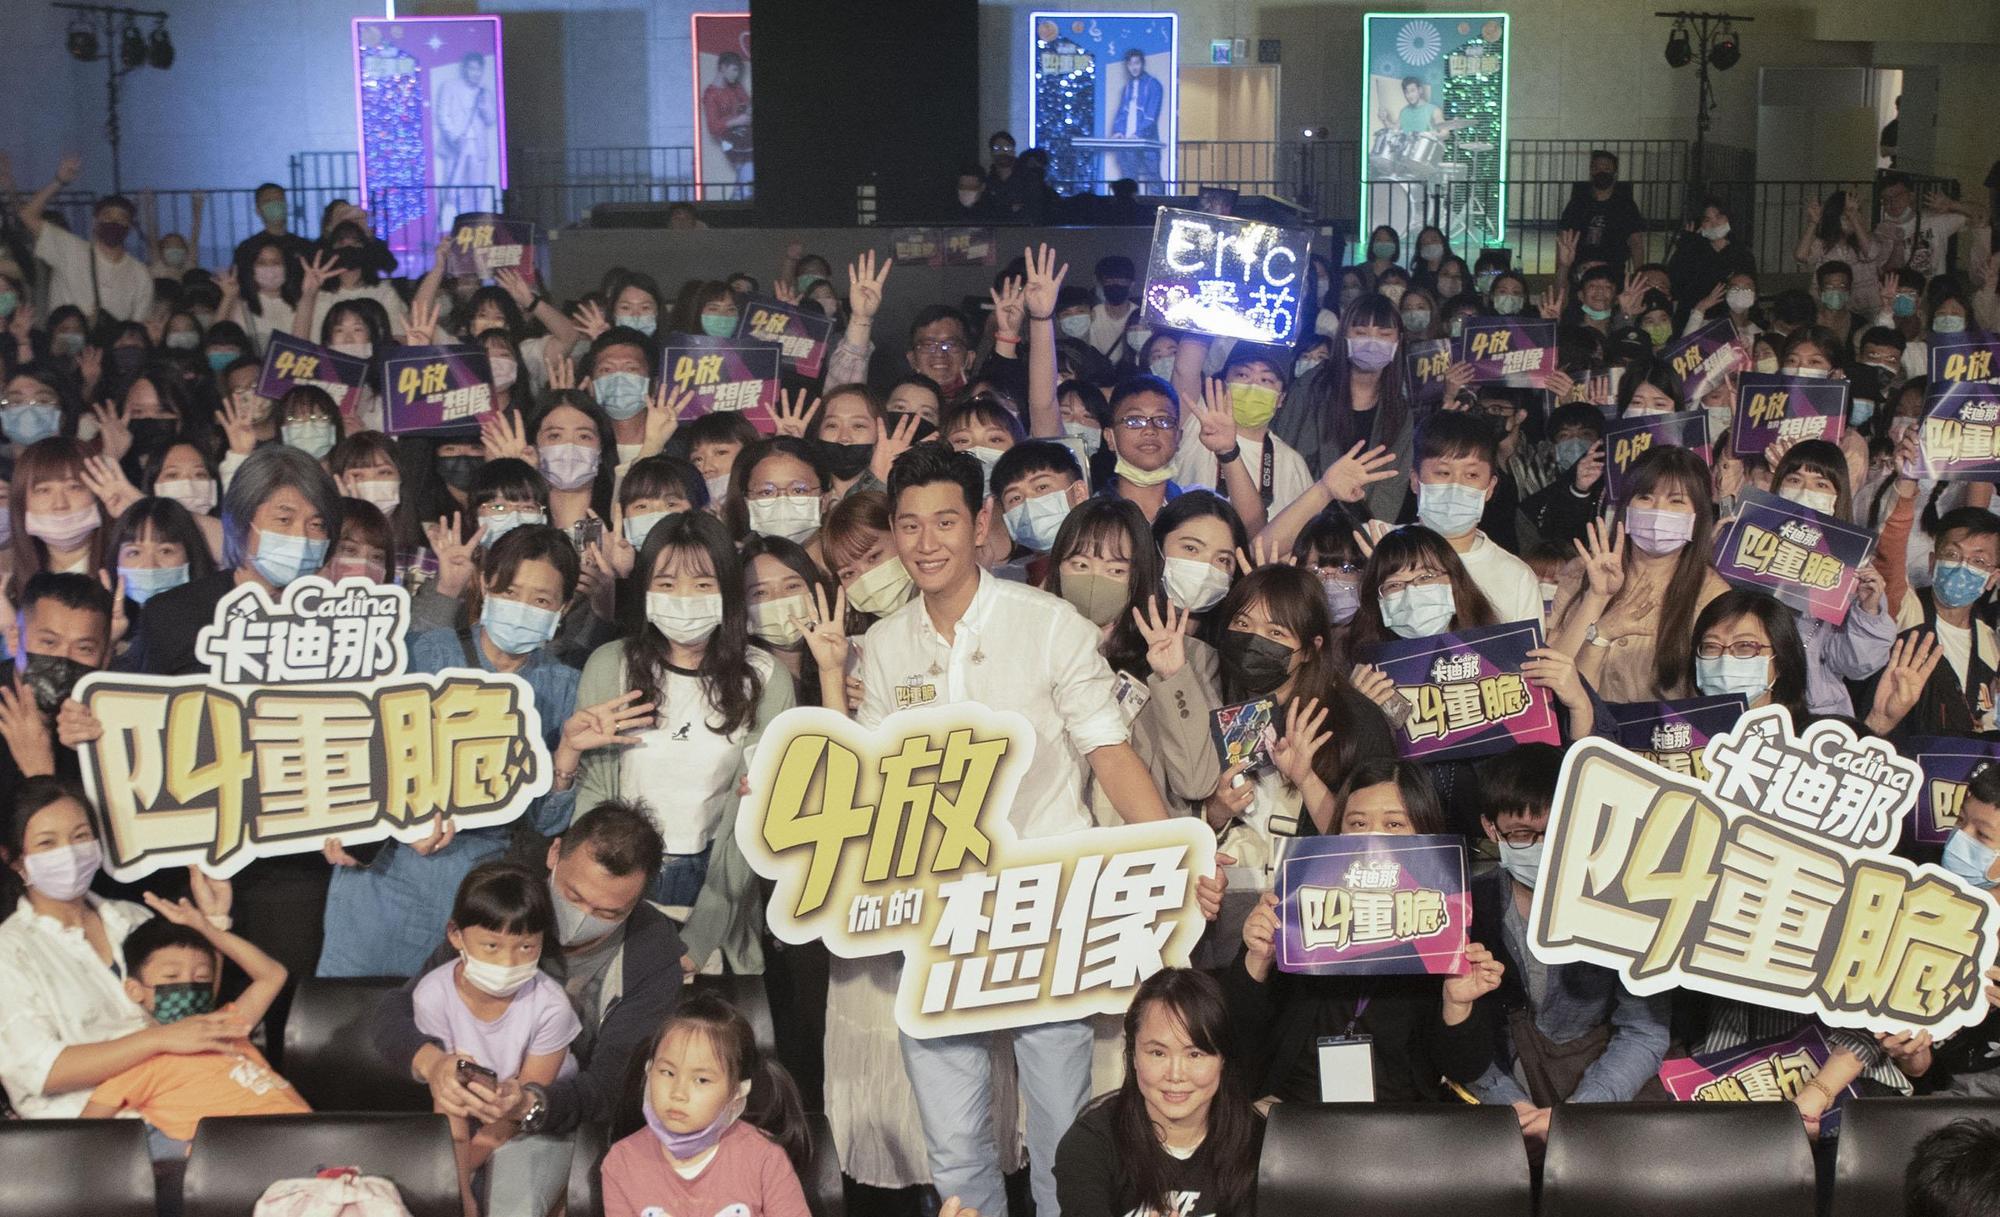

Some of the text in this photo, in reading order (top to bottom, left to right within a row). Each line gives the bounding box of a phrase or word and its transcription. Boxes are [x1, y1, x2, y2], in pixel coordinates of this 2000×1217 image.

[1472, 330, 1512, 361] 4放
[397, 363, 449, 405] 4放
[674, 355, 724, 395] 4放
[1748, 392, 1789, 429] 4放
[1927, 418, 2000, 464] 四重
[293, 588, 398, 618] Cadina
[208, 605, 395, 683] 卡迪那
[1812, 732, 1912, 791] Cadina
[1715, 730, 1902, 844] 卡迪那
[763, 729, 1009, 918] 4放
